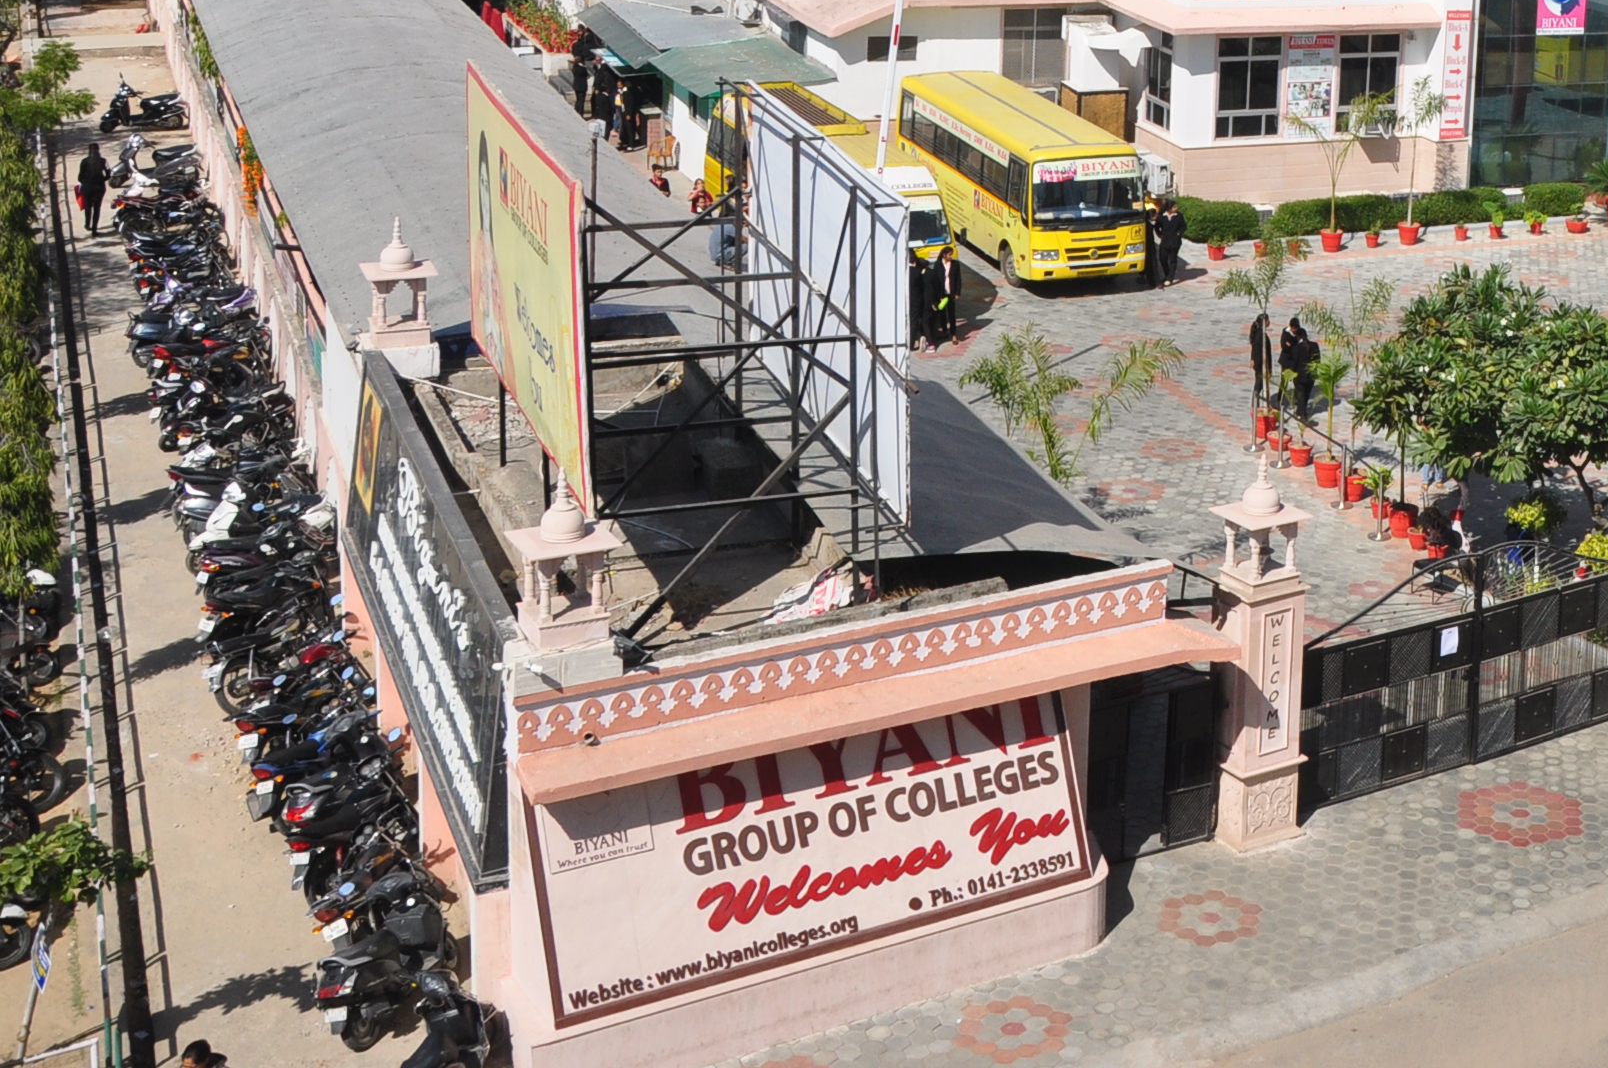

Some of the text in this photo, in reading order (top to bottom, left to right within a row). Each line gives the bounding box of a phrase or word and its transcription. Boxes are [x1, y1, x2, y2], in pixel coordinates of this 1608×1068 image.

[1541, 17, 1577, 28] BIYANI
[891, 182, 934, 190] COLLEGES
[1081, 159, 1136, 172] BIYANI
[510, 161, 548, 247] BIYANI
[1266, 614, 1285, 740] WELCOME
[675, 694, 1056, 835] BIYANI
[573, 830, 629, 856] BIYANI
[682, 750, 1060, 876] GROUP OF COLLEGES
[557, 841, 649, 869] Where you can trust
[696, 807, 1071, 932] Welcomes You
[929, 850, 1075, 908] Ph.: 0141-2338591
[568, 976, 645, 1012] Website
[655, 913, 859, 987] www.biyanicolleges.org
